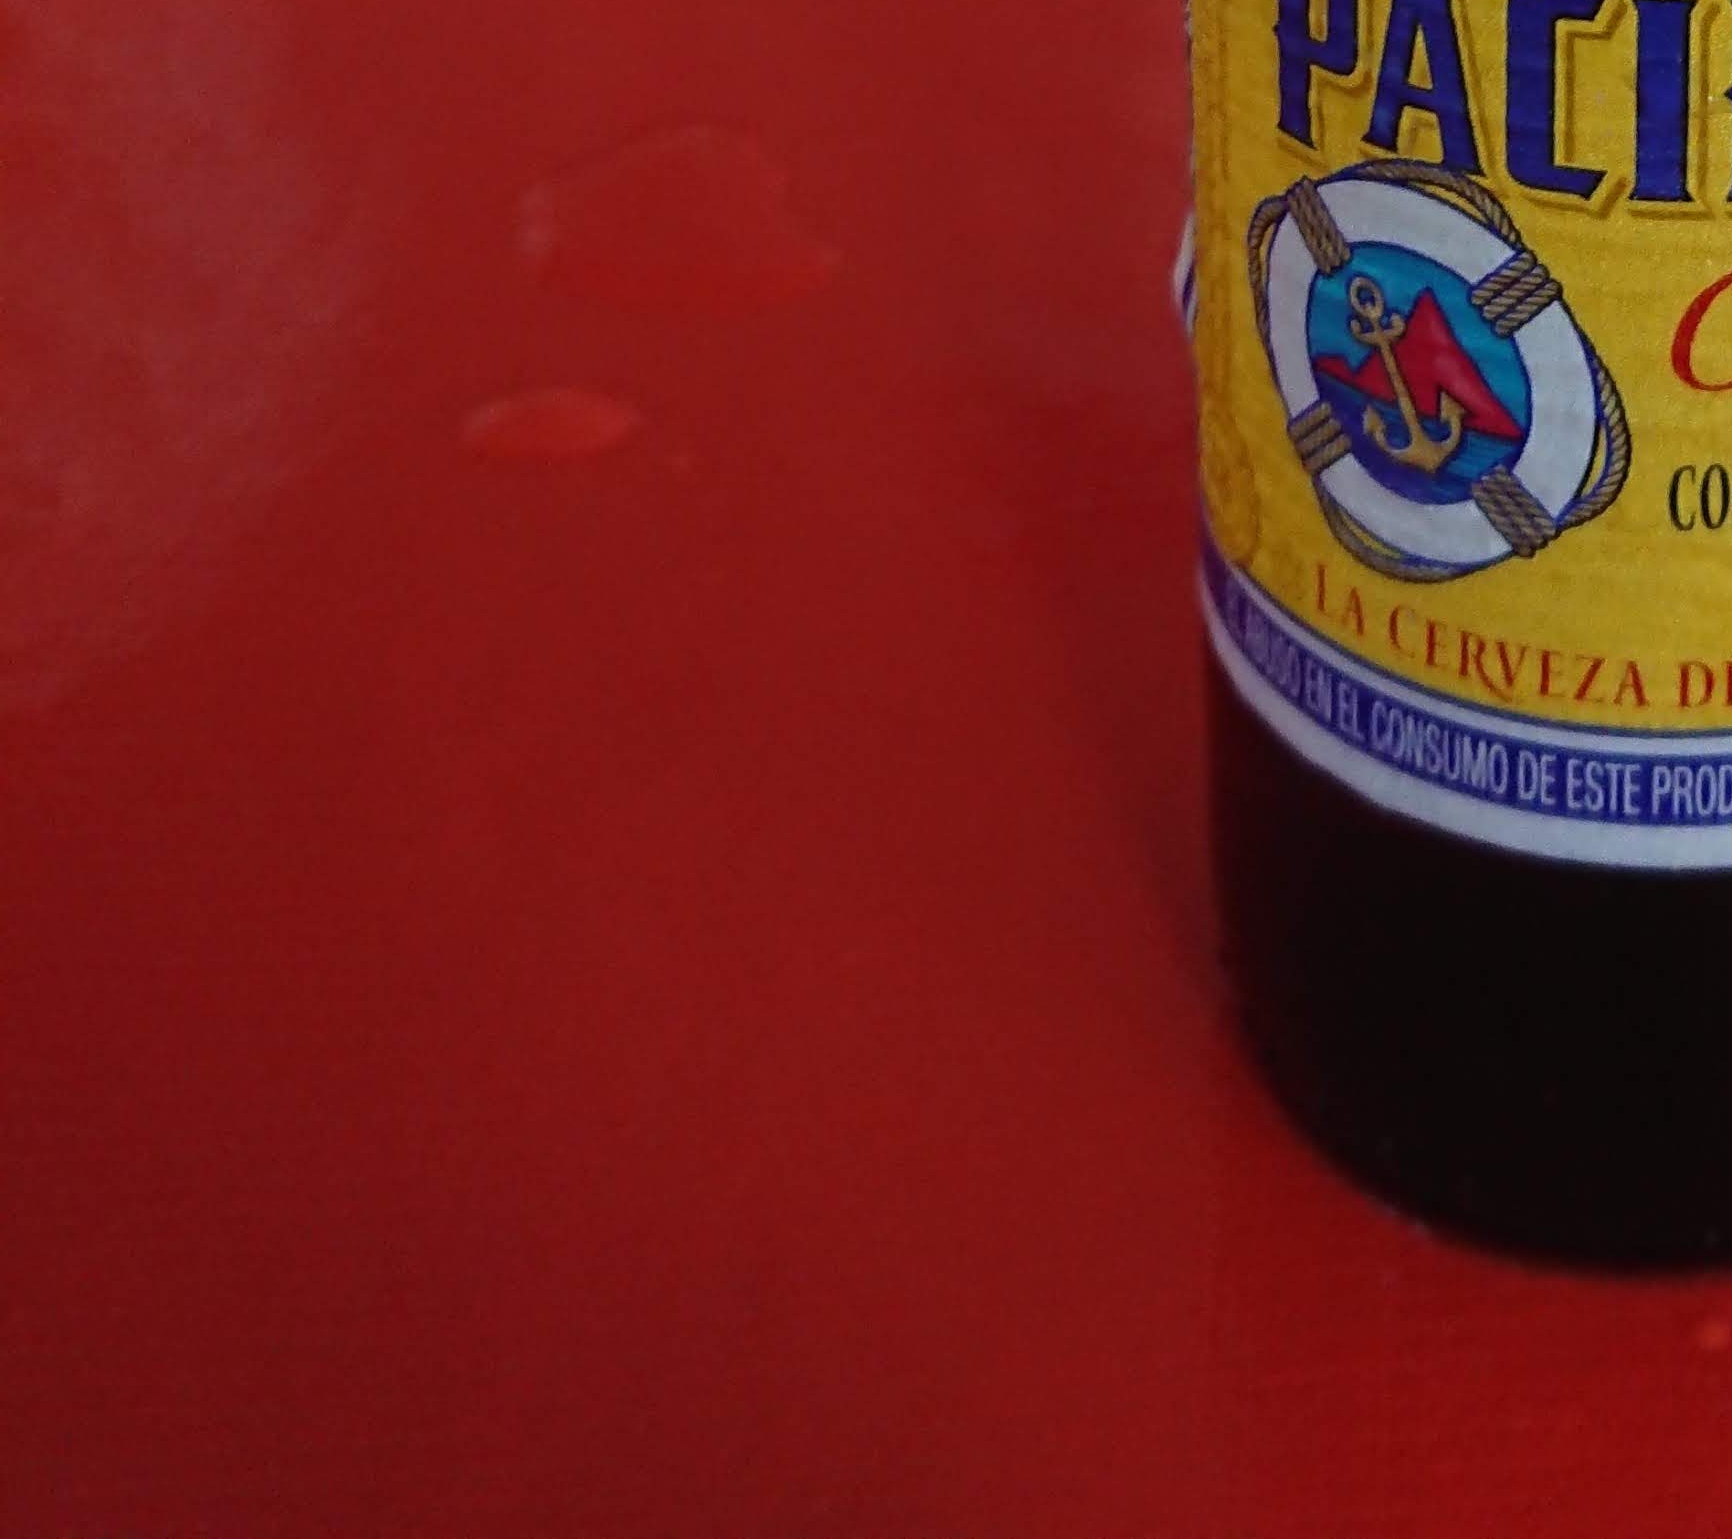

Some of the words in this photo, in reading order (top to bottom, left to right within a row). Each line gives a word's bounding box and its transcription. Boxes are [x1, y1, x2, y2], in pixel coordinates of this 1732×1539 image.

[1313, 561, 1366, 637] LA
[1388, 603, 1650, 709] CERVEZA
[1370, 697, 1510, 796] CONSUMO
[1516, 747, 1557, 807] DE
[1565, 757, 1642, 817] ESTE
